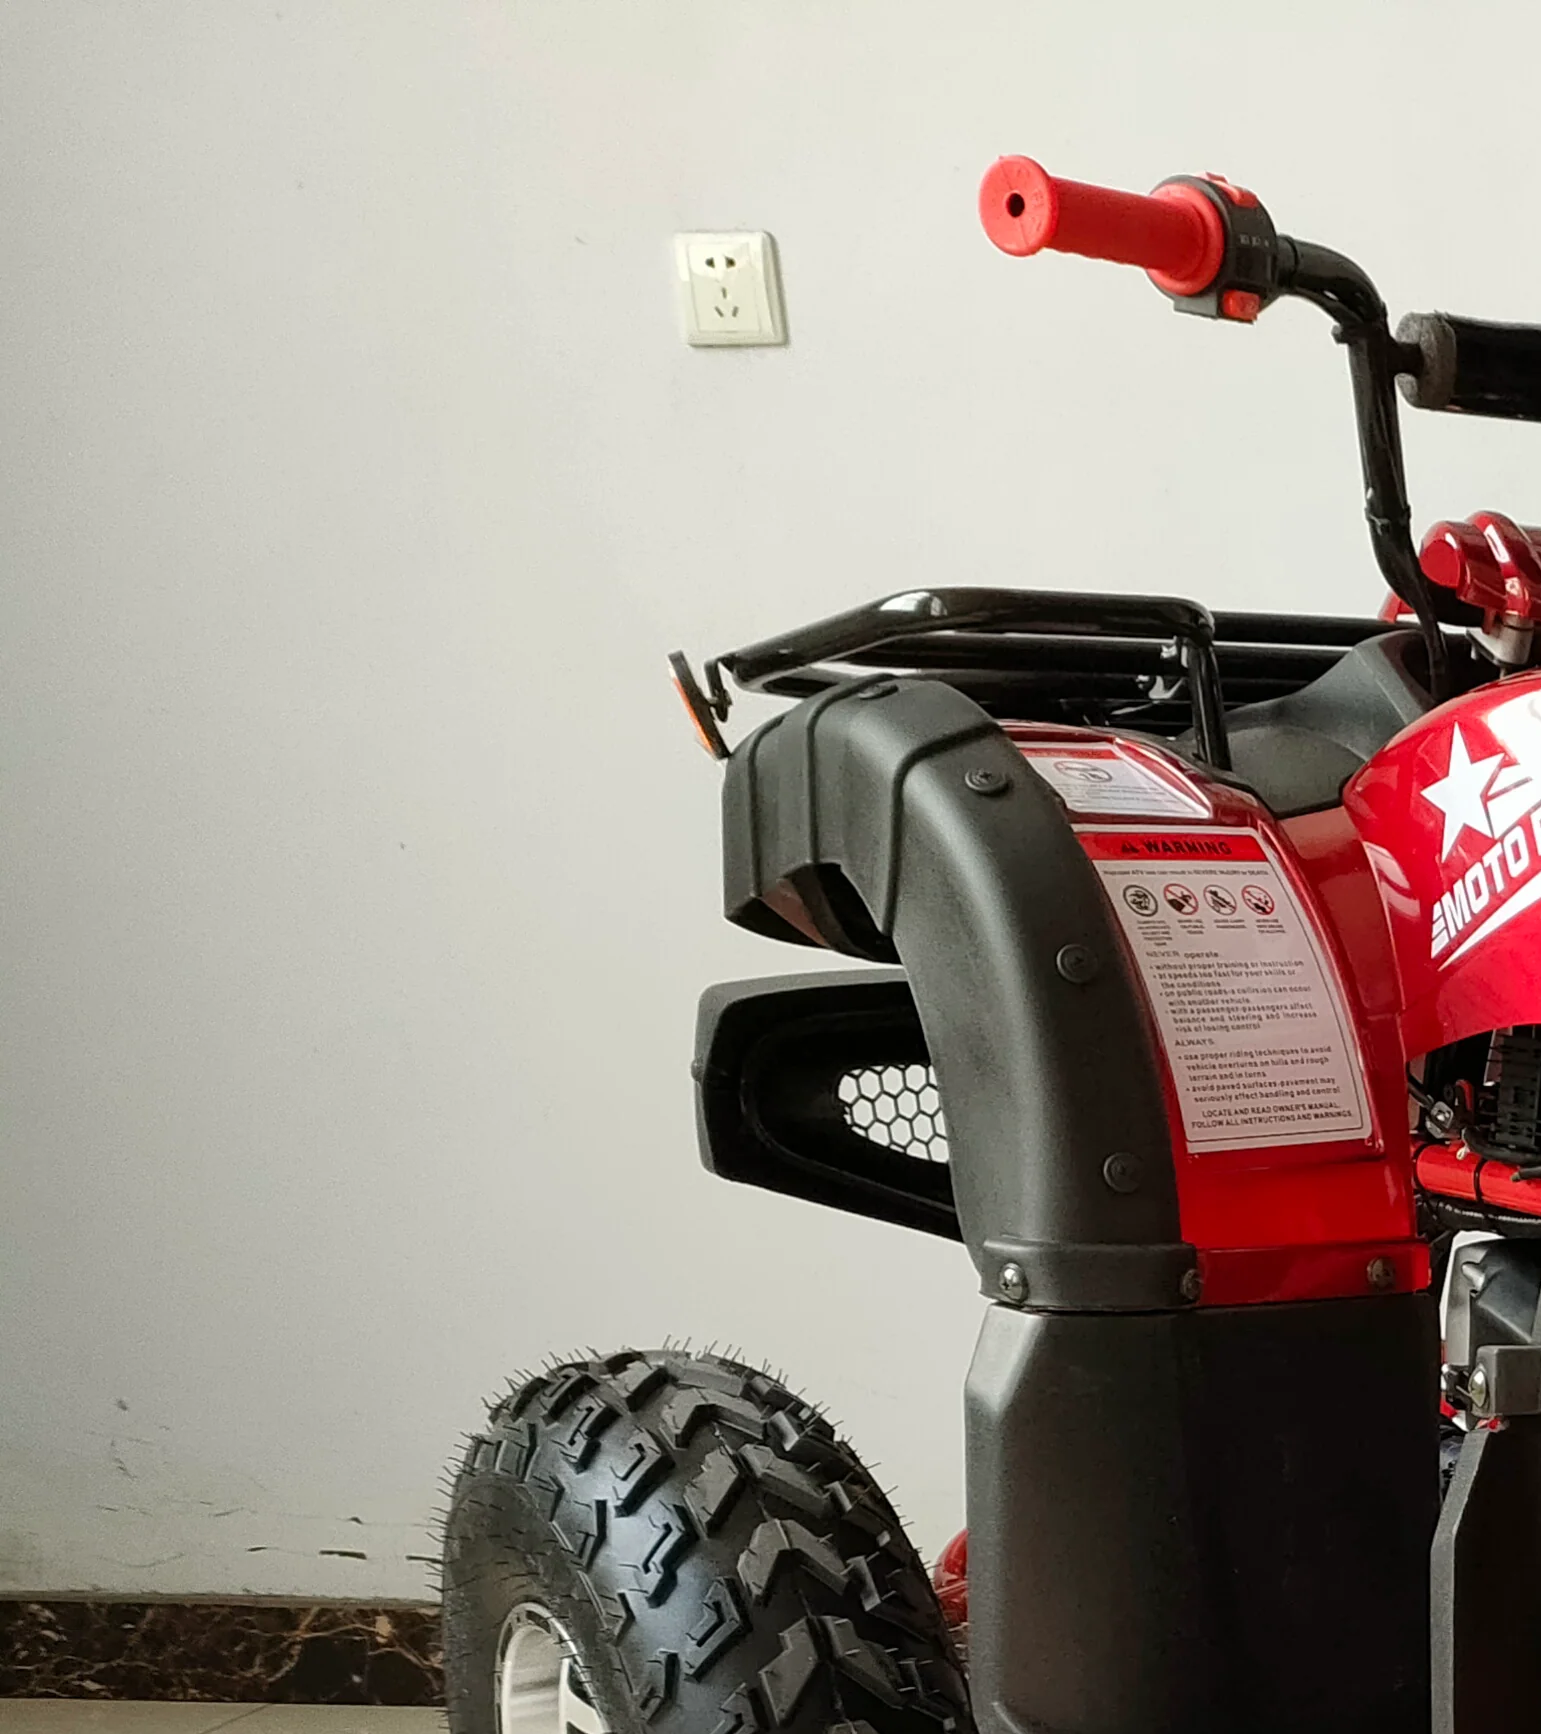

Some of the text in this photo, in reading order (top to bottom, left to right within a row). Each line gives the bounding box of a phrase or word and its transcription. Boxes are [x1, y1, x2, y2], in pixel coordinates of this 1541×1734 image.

[1142, 840, 1233, 855] WARNING
[1174, 1038, 1215, 1047] ALWAYS
[1202, 1108, 1233, 1118] LOCATE
[1234, 1107, 1250, 1116] AND
[1191, 1120, 1225, 1129] FOLLOW
[1226, 1118, 1241, 1127] ALL
